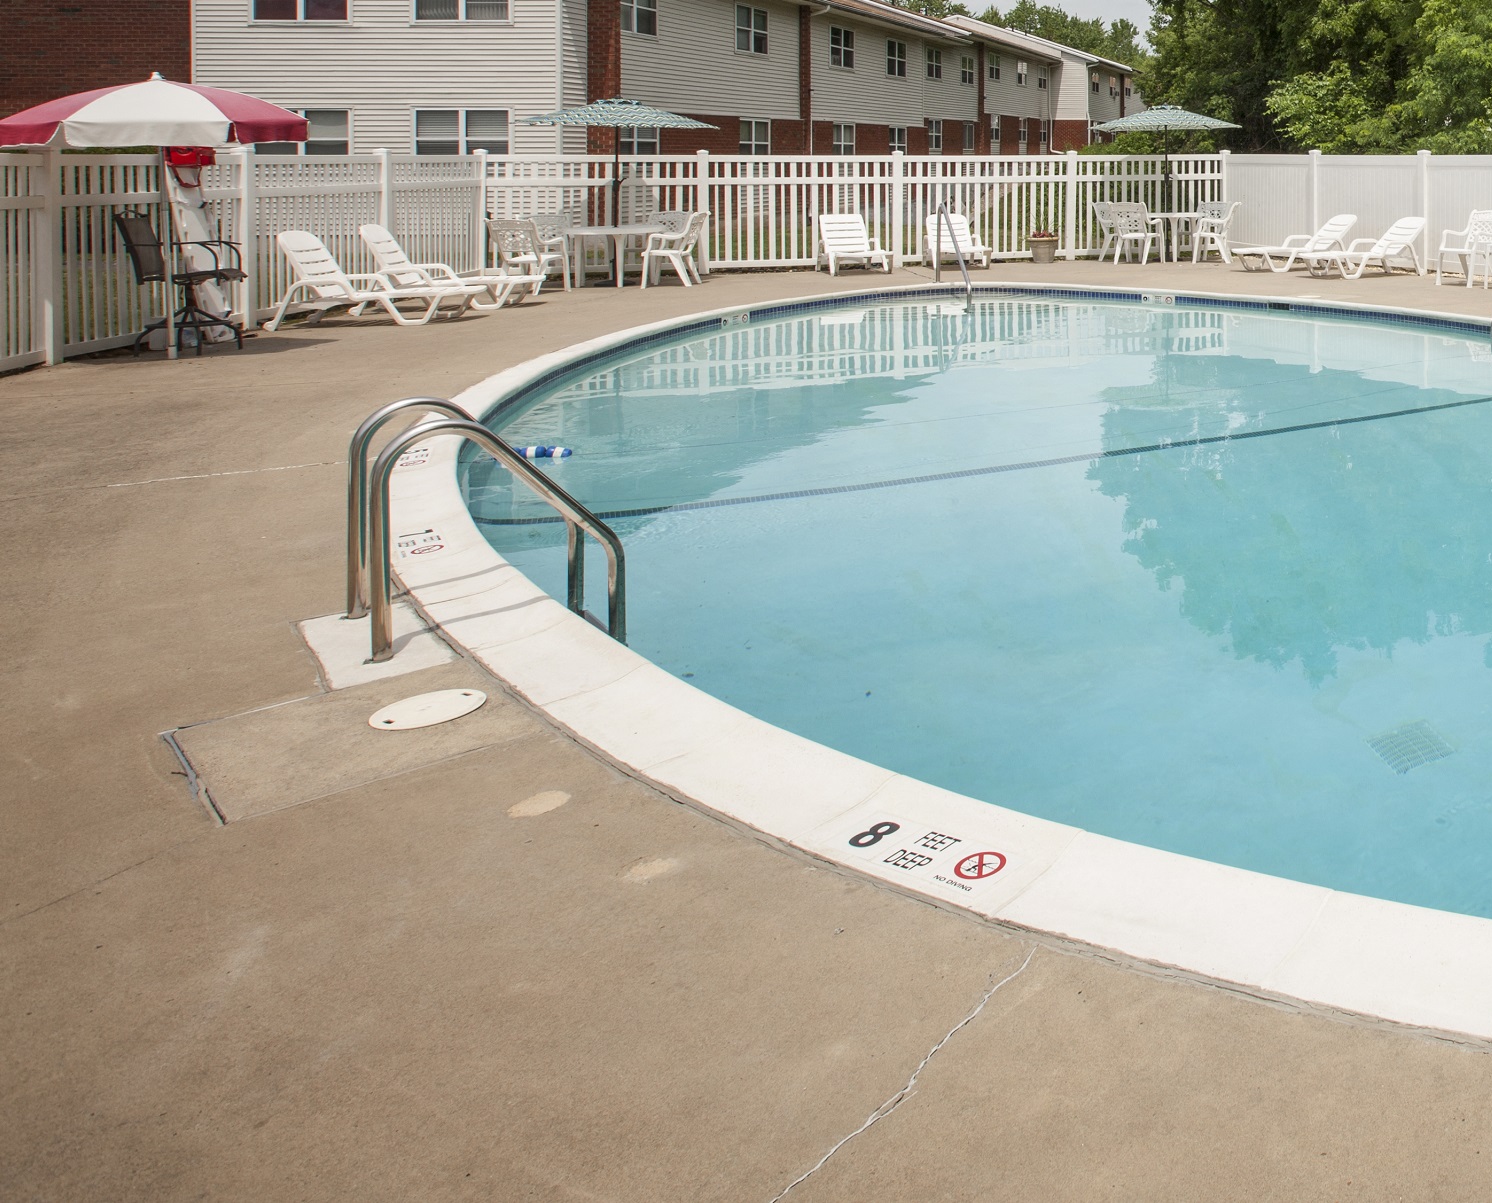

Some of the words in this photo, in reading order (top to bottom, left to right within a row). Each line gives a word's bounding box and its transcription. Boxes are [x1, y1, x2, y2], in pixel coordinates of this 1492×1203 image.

[848, 820, 901, 848] 8
[913, 831, 962, 852] FEET
[882, 848, 933, 871] DEEP
[933, 874, 947, 882] NO
[945, 879, 973, 892] DIVING
